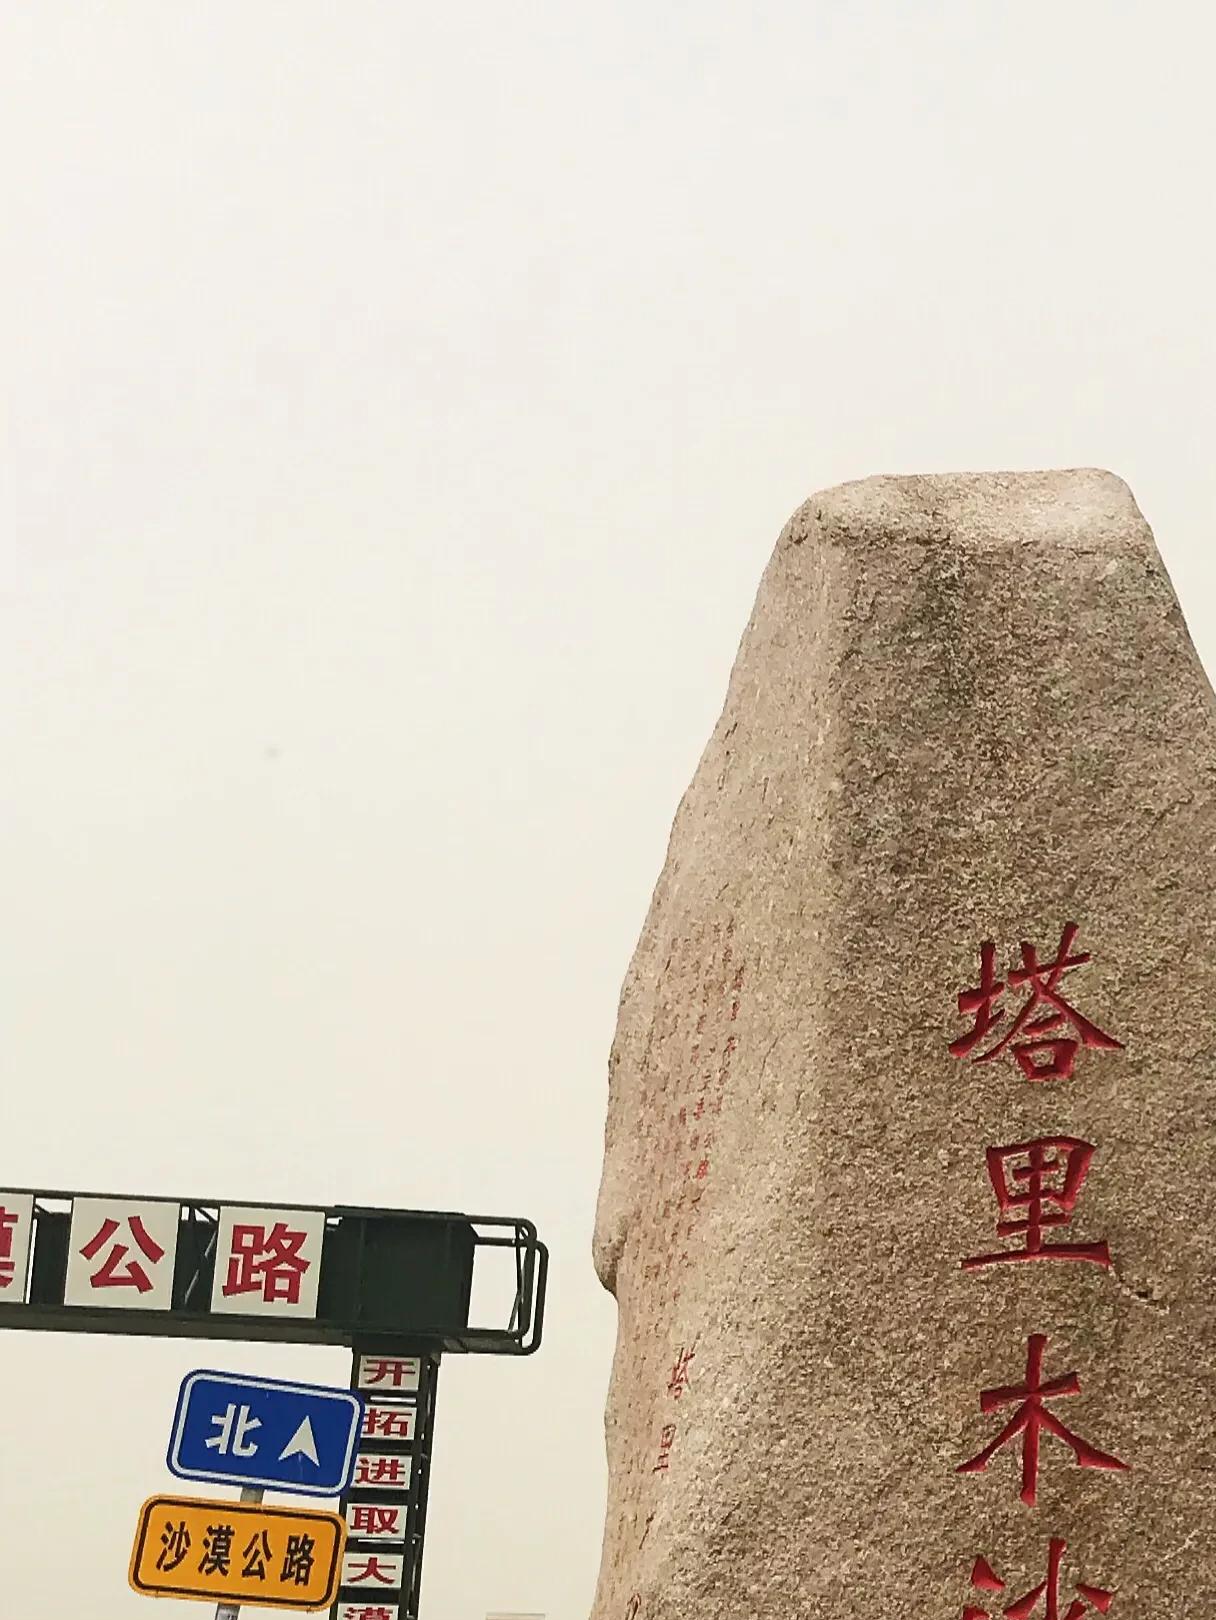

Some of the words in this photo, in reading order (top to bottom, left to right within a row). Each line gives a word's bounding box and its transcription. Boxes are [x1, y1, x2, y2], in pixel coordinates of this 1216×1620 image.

[0, 1206, 311, 1304] 公路
[205, 1403, 262, 1457] 北
[156, 1521, 316, 1587] 沙漠公路
